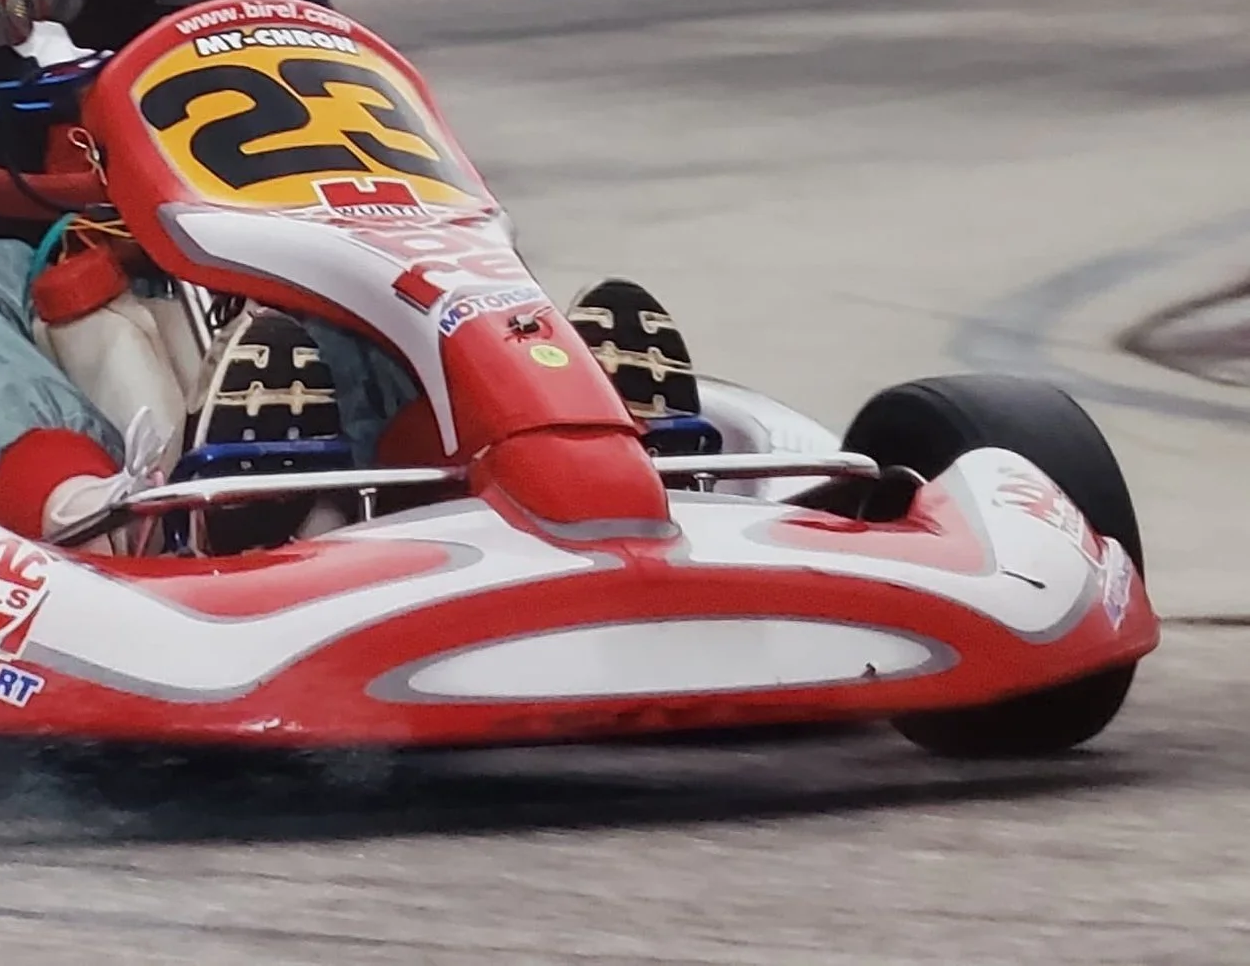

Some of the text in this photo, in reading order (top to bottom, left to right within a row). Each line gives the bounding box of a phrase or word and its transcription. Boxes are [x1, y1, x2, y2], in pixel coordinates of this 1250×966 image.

[175, 1, 352, 34] www.birel.com
[194, 28, 359, 56] MY-CHRON
[139, 57, 472, 191] 23
